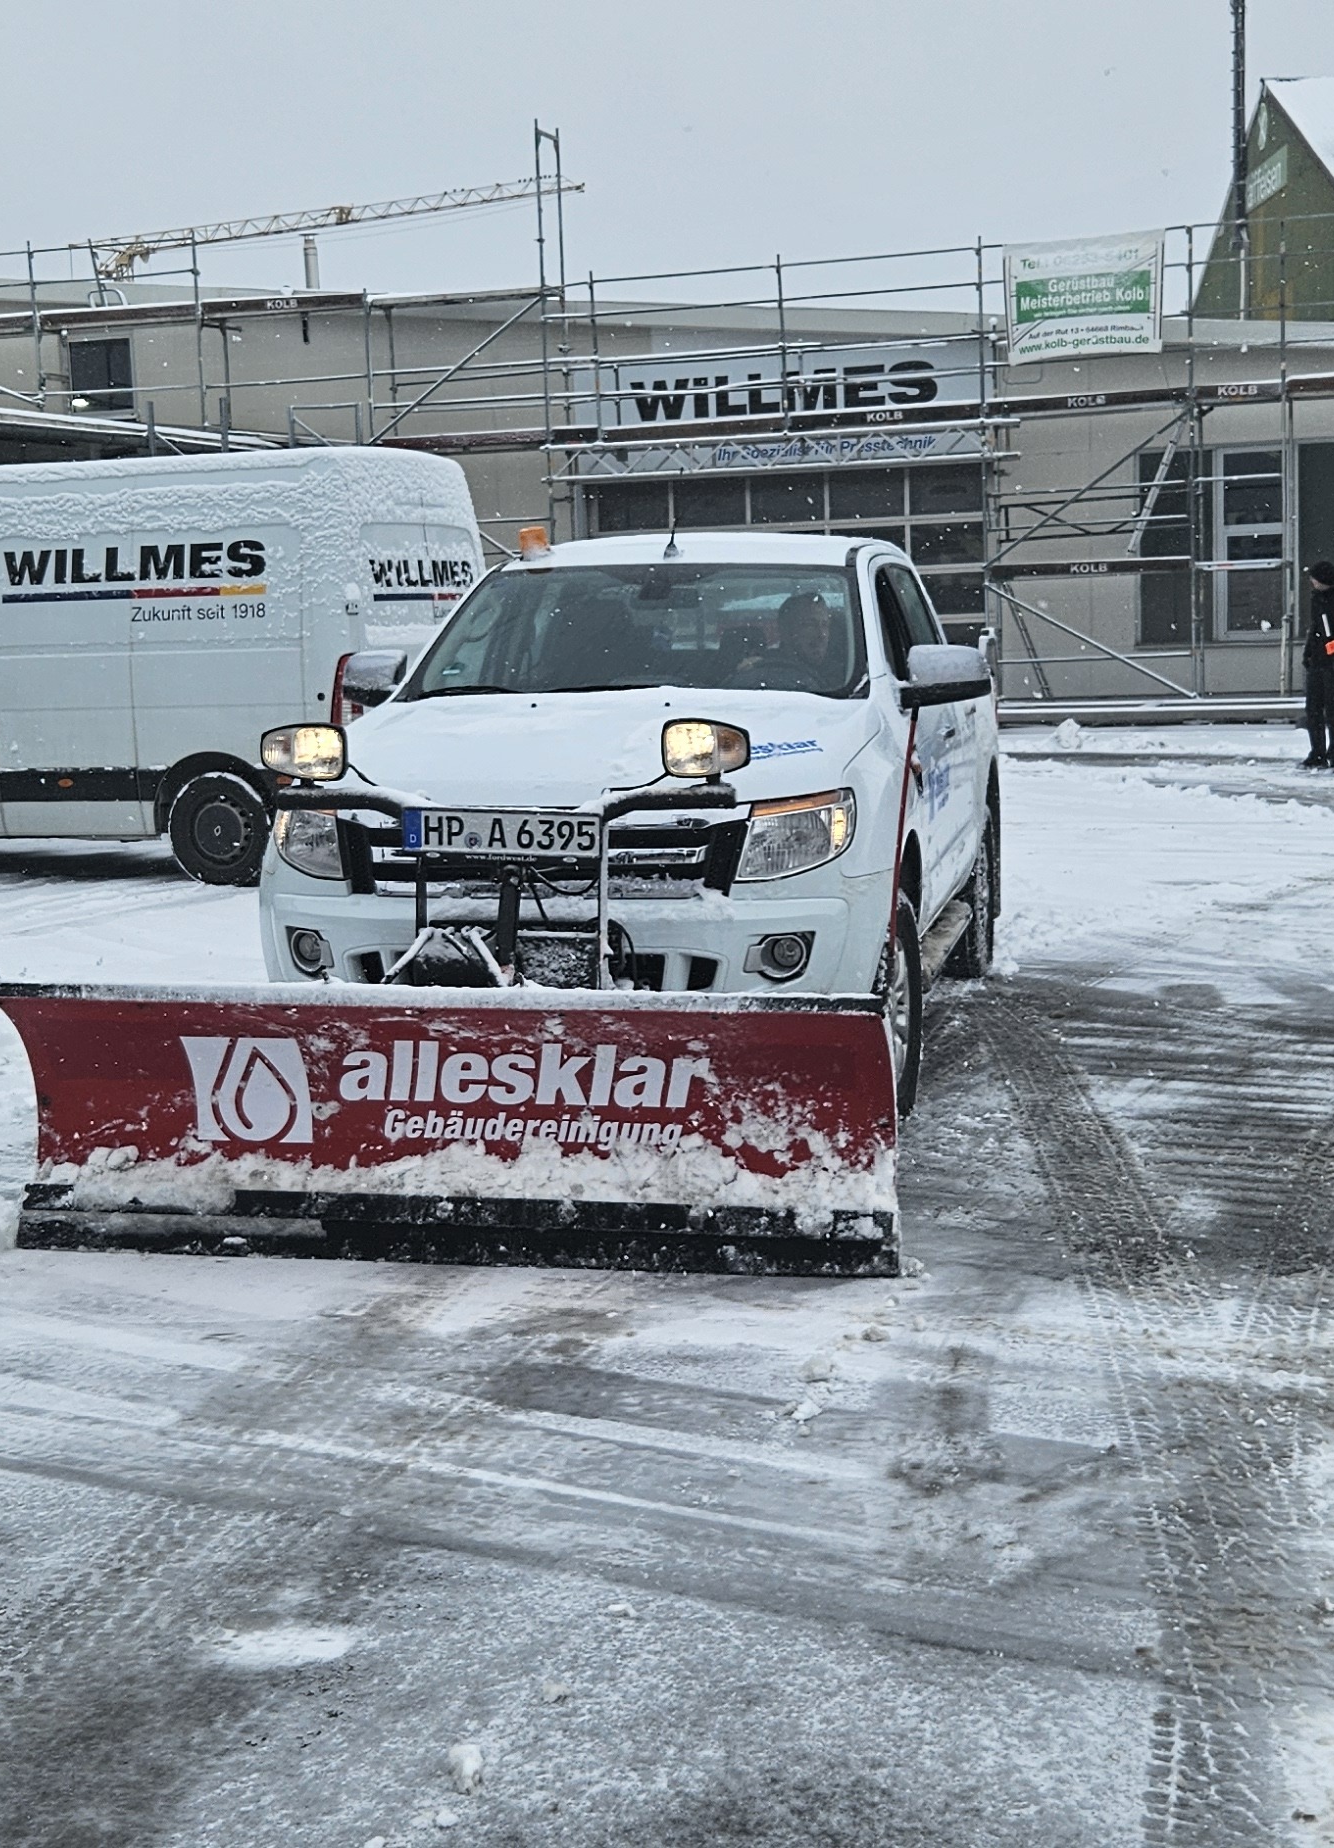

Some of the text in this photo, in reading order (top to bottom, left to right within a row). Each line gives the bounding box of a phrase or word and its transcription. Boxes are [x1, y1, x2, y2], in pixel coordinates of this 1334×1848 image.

[1048, 275, 1115, 293] Gerüstbau
[267, 299, 298, 310] KOLB
[1020, 286, 1145, 312] Meisterbetrieb Kolb
[1070, 327, 1079, 335] 13
[1110, 324, 1144, 332] Rimba
[630, 360, 938, 422] WILLMES
[1216, 385, 1259, 397] KOLB
[1067, 395, 1107, 408] KOLB
[867, 410, 904, 424] KOLB
[717, 448, 738, 462] Ihr
[3, 540, 267, 587] WILLMES
[1069, 562, 1109, 574] KOLB
[369, 559, 474, 588] WILLMES
[130, 602, 267, 623] Zukunft seit 1918
[409, 815, 597, 851] D HP A 6395
[338, 1039, 711, 1109] allesklar
[384, 1108, 684, 1152] Gebäudereinigung
